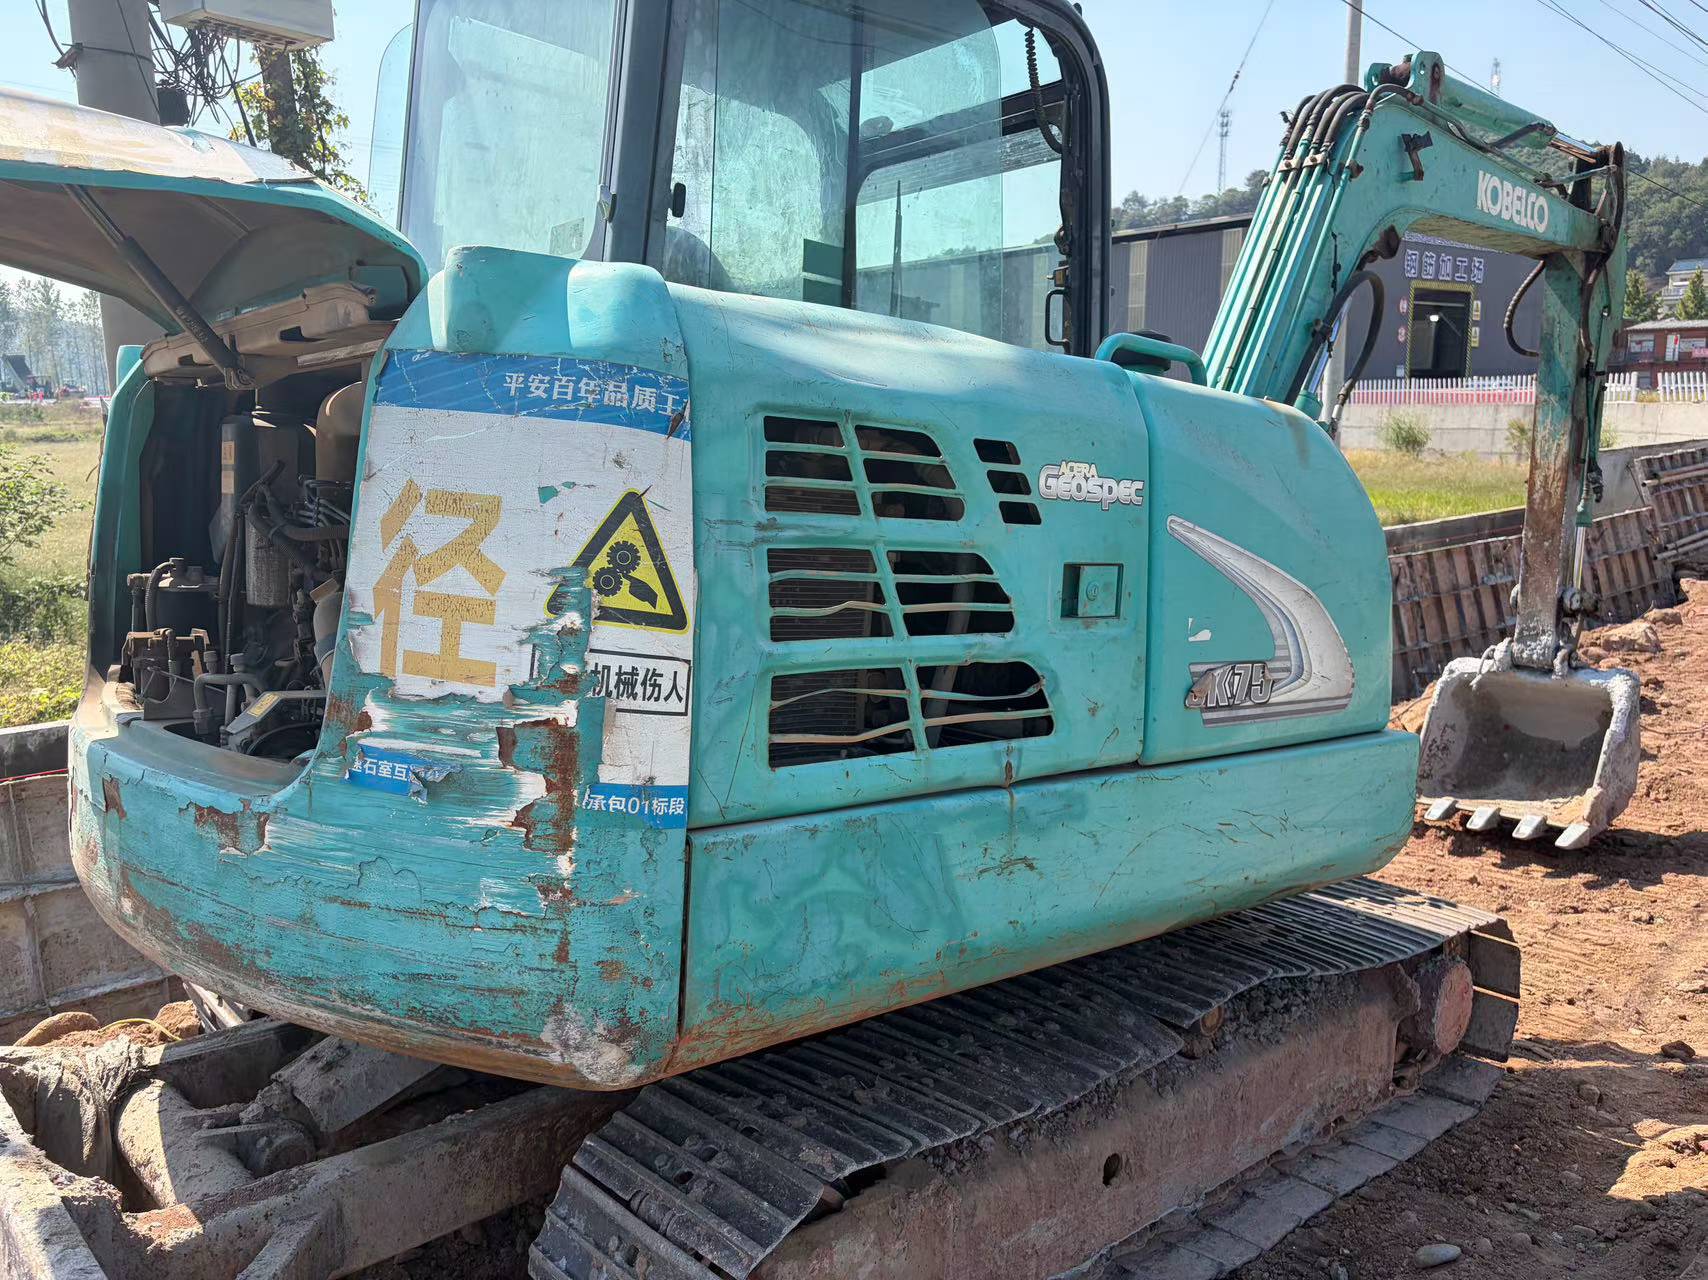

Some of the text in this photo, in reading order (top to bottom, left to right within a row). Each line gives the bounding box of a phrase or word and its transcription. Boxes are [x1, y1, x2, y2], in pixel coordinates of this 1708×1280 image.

[1476, 170, 1549, 233] KOBELCO
[503, 372, 689, 416] 平安百年品质工
[1058, 461, 1098, 478] ACERA
[590, 662, 684, 703] 机械伤人
